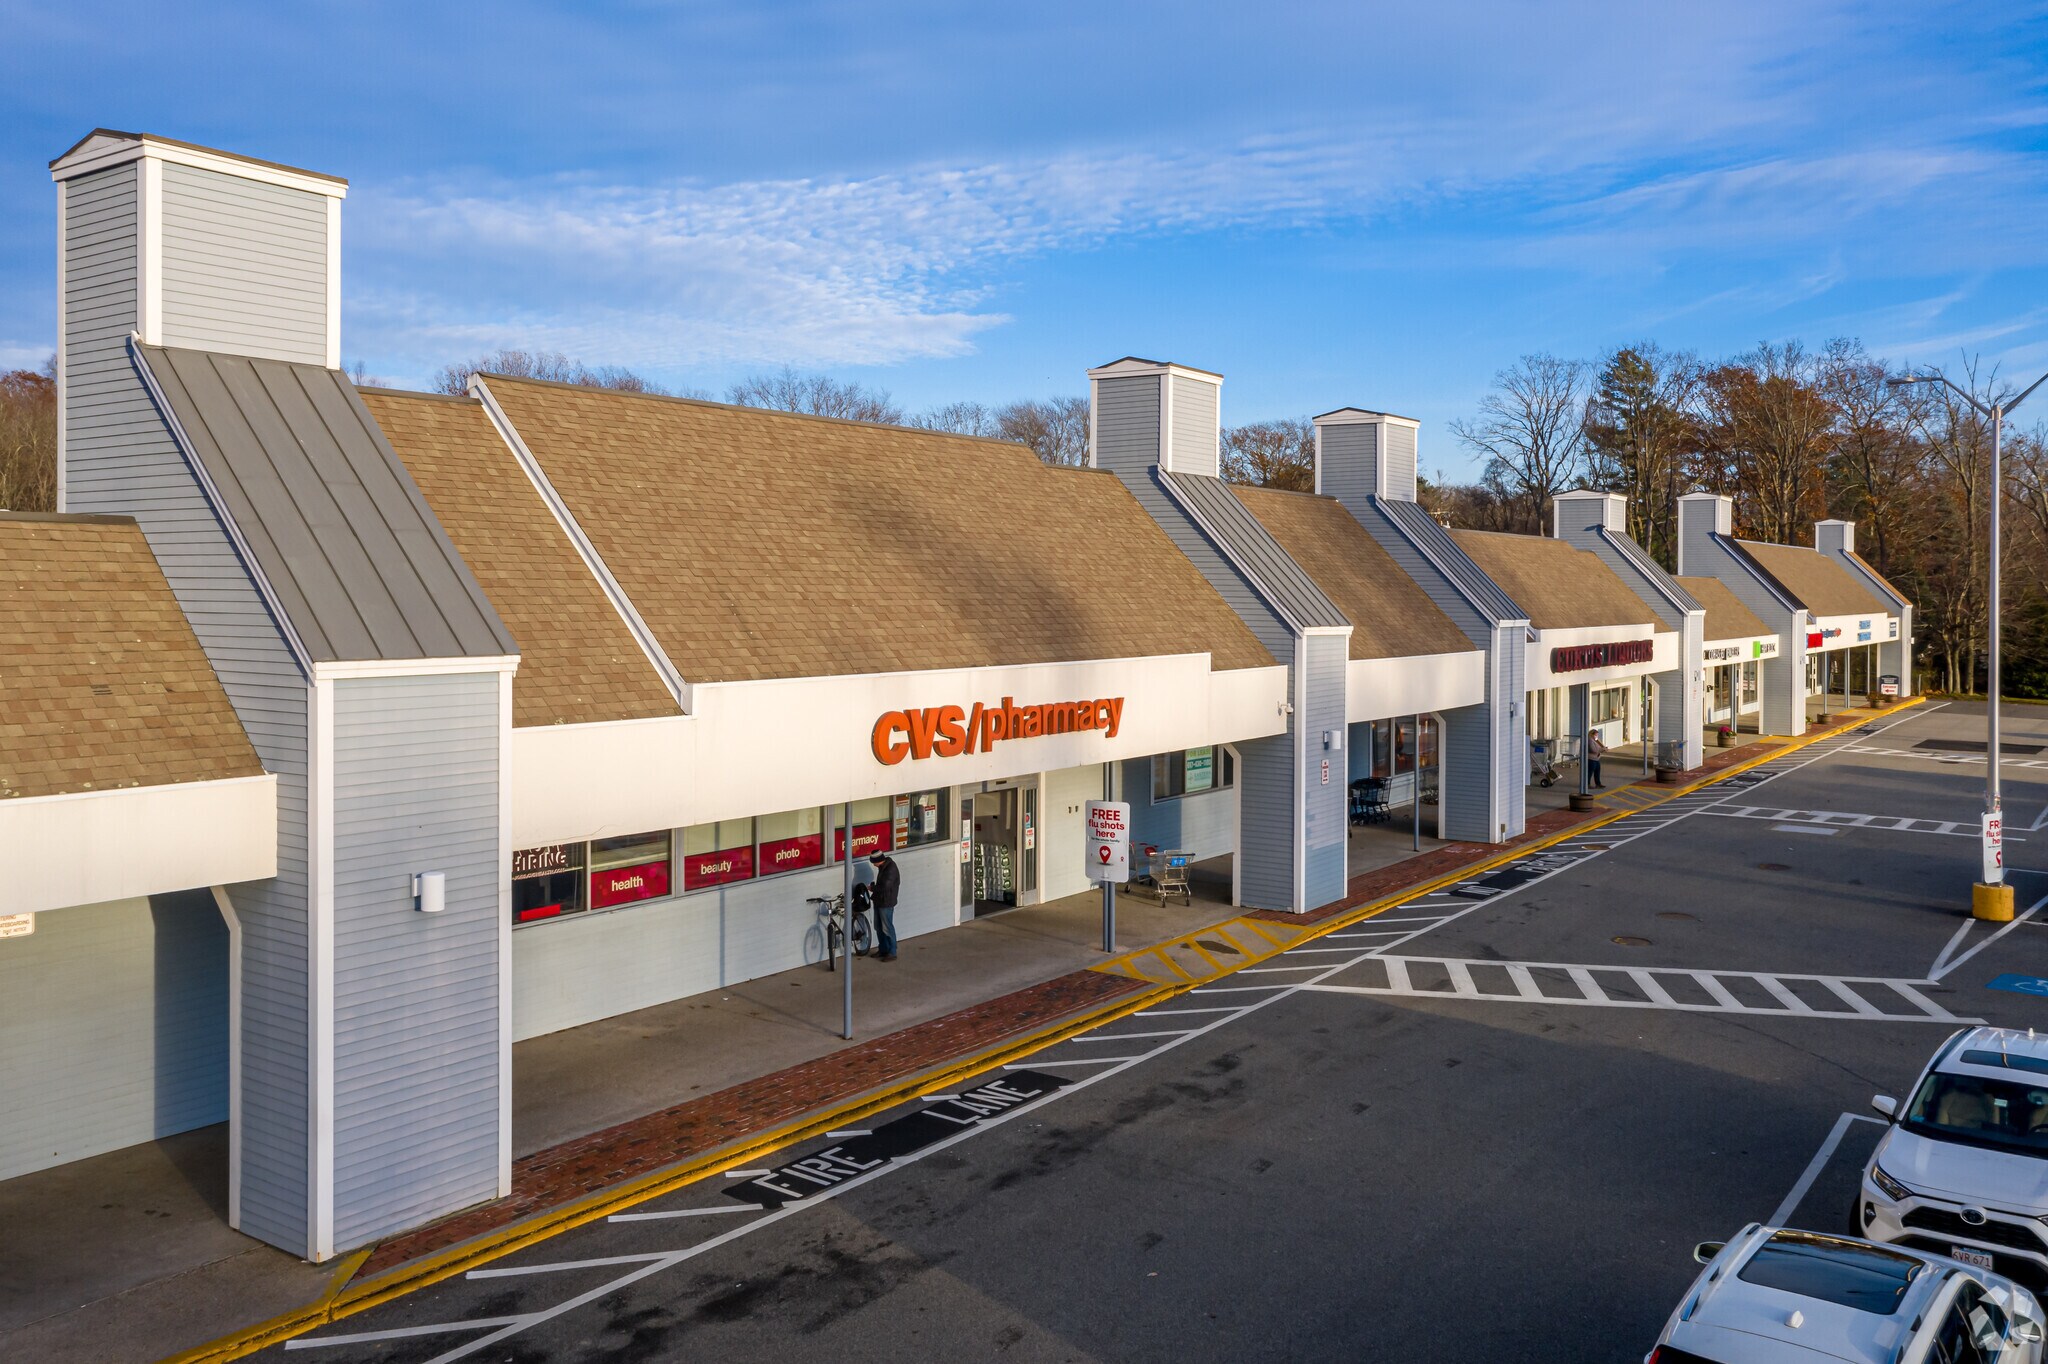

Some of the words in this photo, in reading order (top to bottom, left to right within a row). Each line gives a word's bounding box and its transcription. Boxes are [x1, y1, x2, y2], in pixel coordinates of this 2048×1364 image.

[1553, 644, 1602, 673] CURTIS
[1607, 639, 1653, 666] LIQUORS
[871, 697, 1125, 766] CVS/pharmacy
[1092, 808, 1121, 821] FREE
[1088, 819, 1099, 828] flu
[1100, 821, 1125, 831] shots
[1095, 829, 1116, 838] here
[841, 834, 879, 851] parmacy
[775, 848, 800, 863] photo
[700, 860, 732, 875] beauty
[611, 876, 644, 892] health
[752, 1146, 883, 1199] FIRE
[921, 1080, 1041, 1126] LANE
